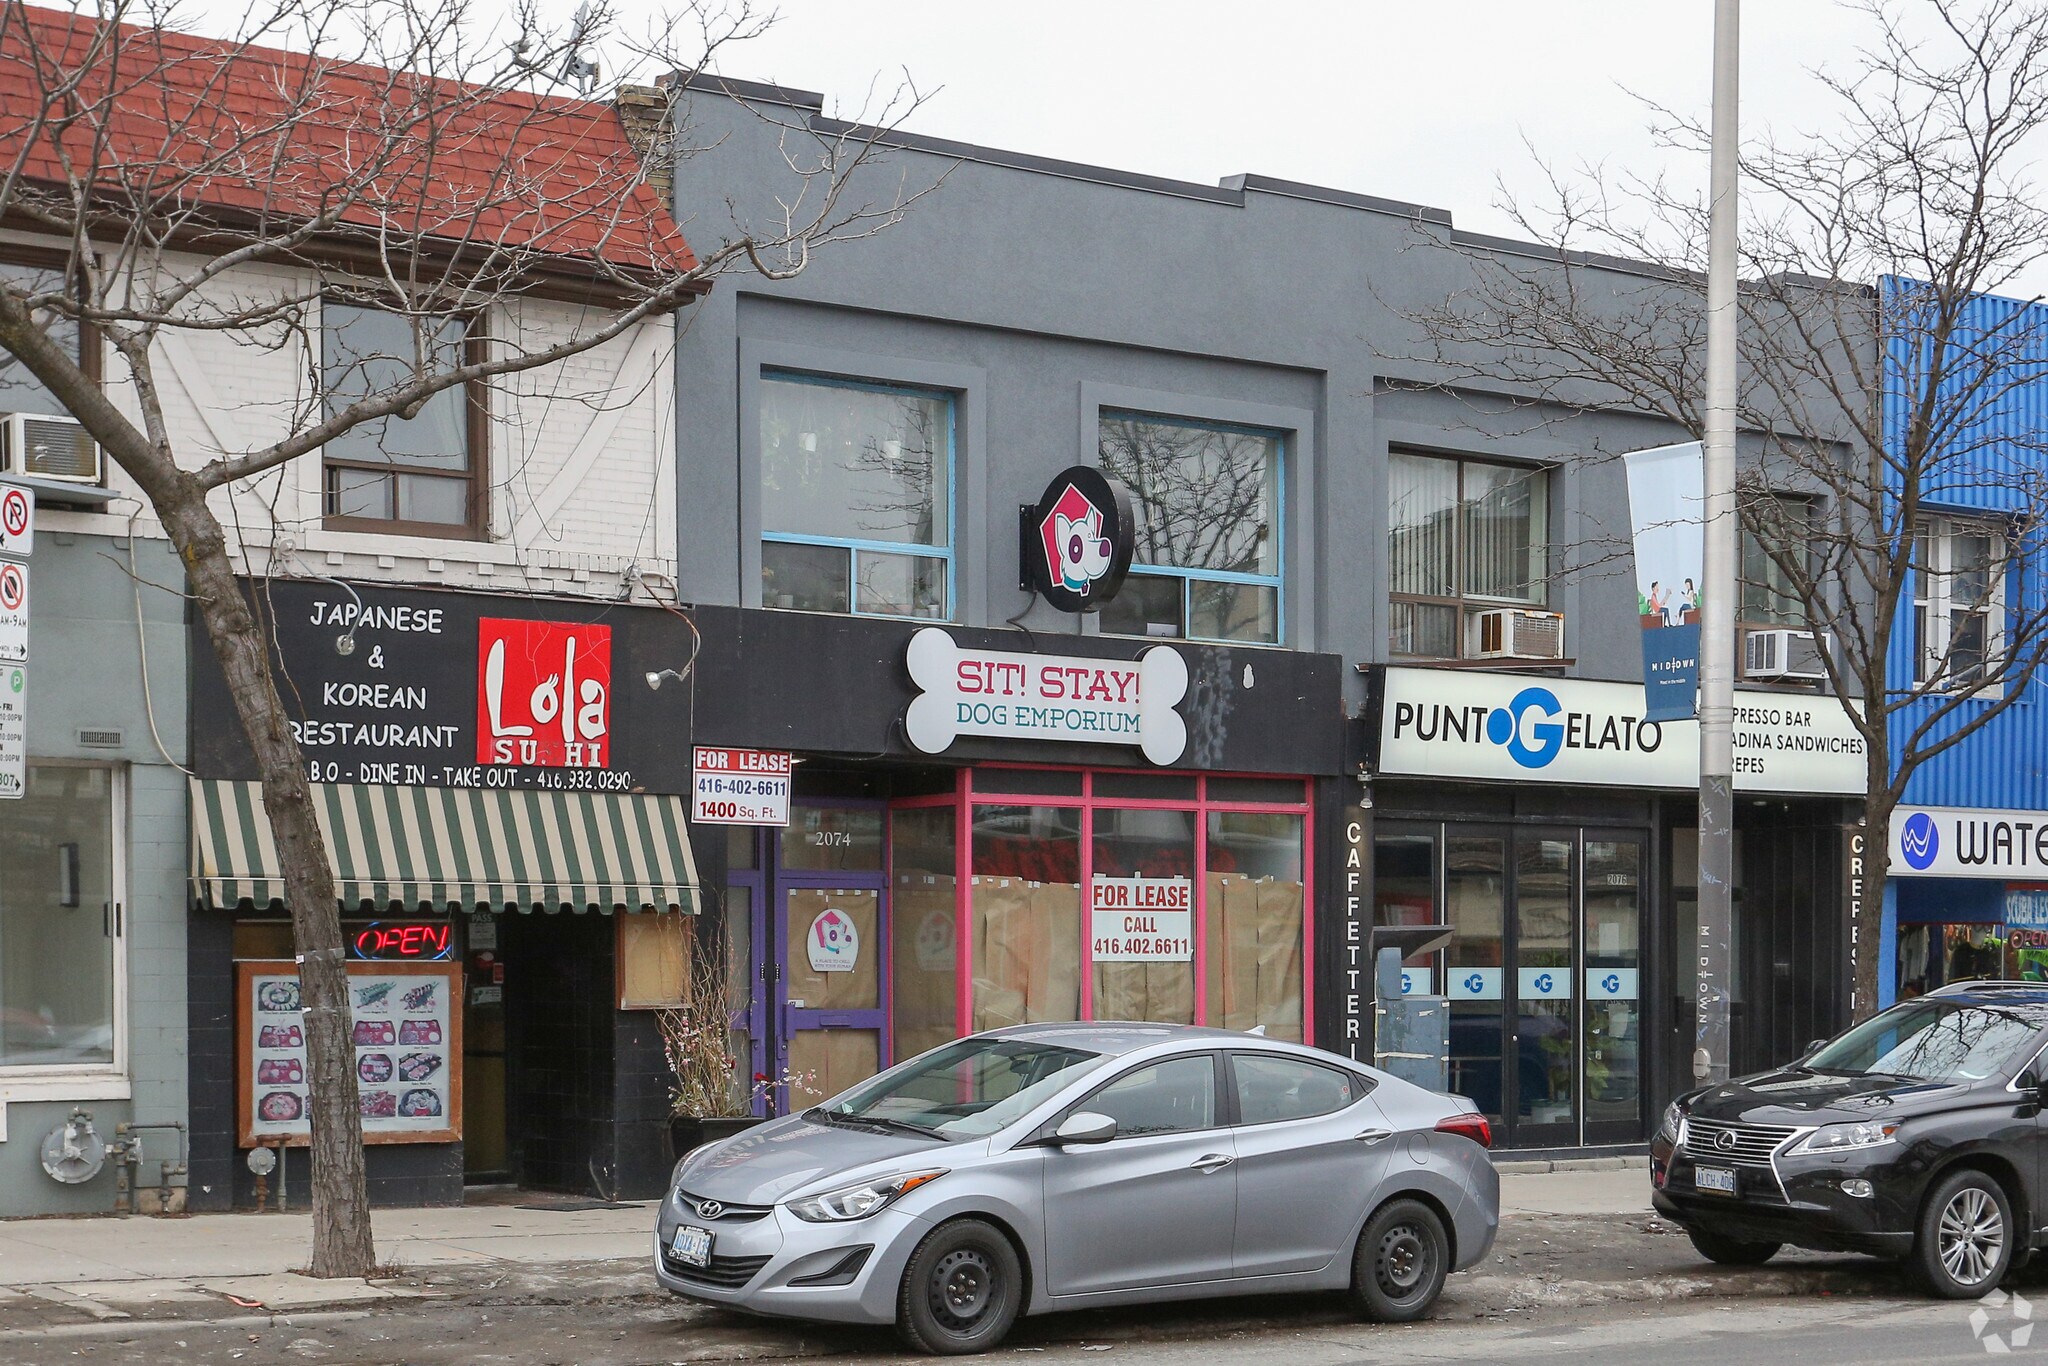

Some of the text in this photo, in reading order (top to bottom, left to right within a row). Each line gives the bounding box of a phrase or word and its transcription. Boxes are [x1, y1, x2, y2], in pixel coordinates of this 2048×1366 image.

[310, 602, 443, 633] JAPANESE
[368, 645, 384, 669] &
[485, 636, 606, 743] Lola
[956, 661, 1140, 704] SIT! STAY!
[323, 682, 426, 710] KOREAN
[3, 703, 12, 711] FRI
[956, 702, 1141, 734] DOG EMPORIUM
[1785, 710, 1811, 727] BAR
[1777, 734, 1863, 754] SANDWICHES
[697, 750, 789, 772] FOR LEASE
[360, 762, 399, 785] DINE
[405, 764, 425, 785] IN
[443, 767, 481, 787] TAKE
[486, 769, 518, 787] OUT
[537, 769, 631, 791] 416.932.0290
[698, 778, 786, 796] 416-402-6611
[700, 801, 777, 820] 1400 Sq. Ft.
[815, 831, 852, 847] 2074
[1607, 874, 1627, 885] 2076
[1093, 885, 1188, 906] FOR LEASE
[472, 914, 492, 922] PASS
[1124, 916, 1157, 932] CALL
[357, 925, 449, 954] OPEN
[1094, 938, 1188, 954] 416.402.6611
